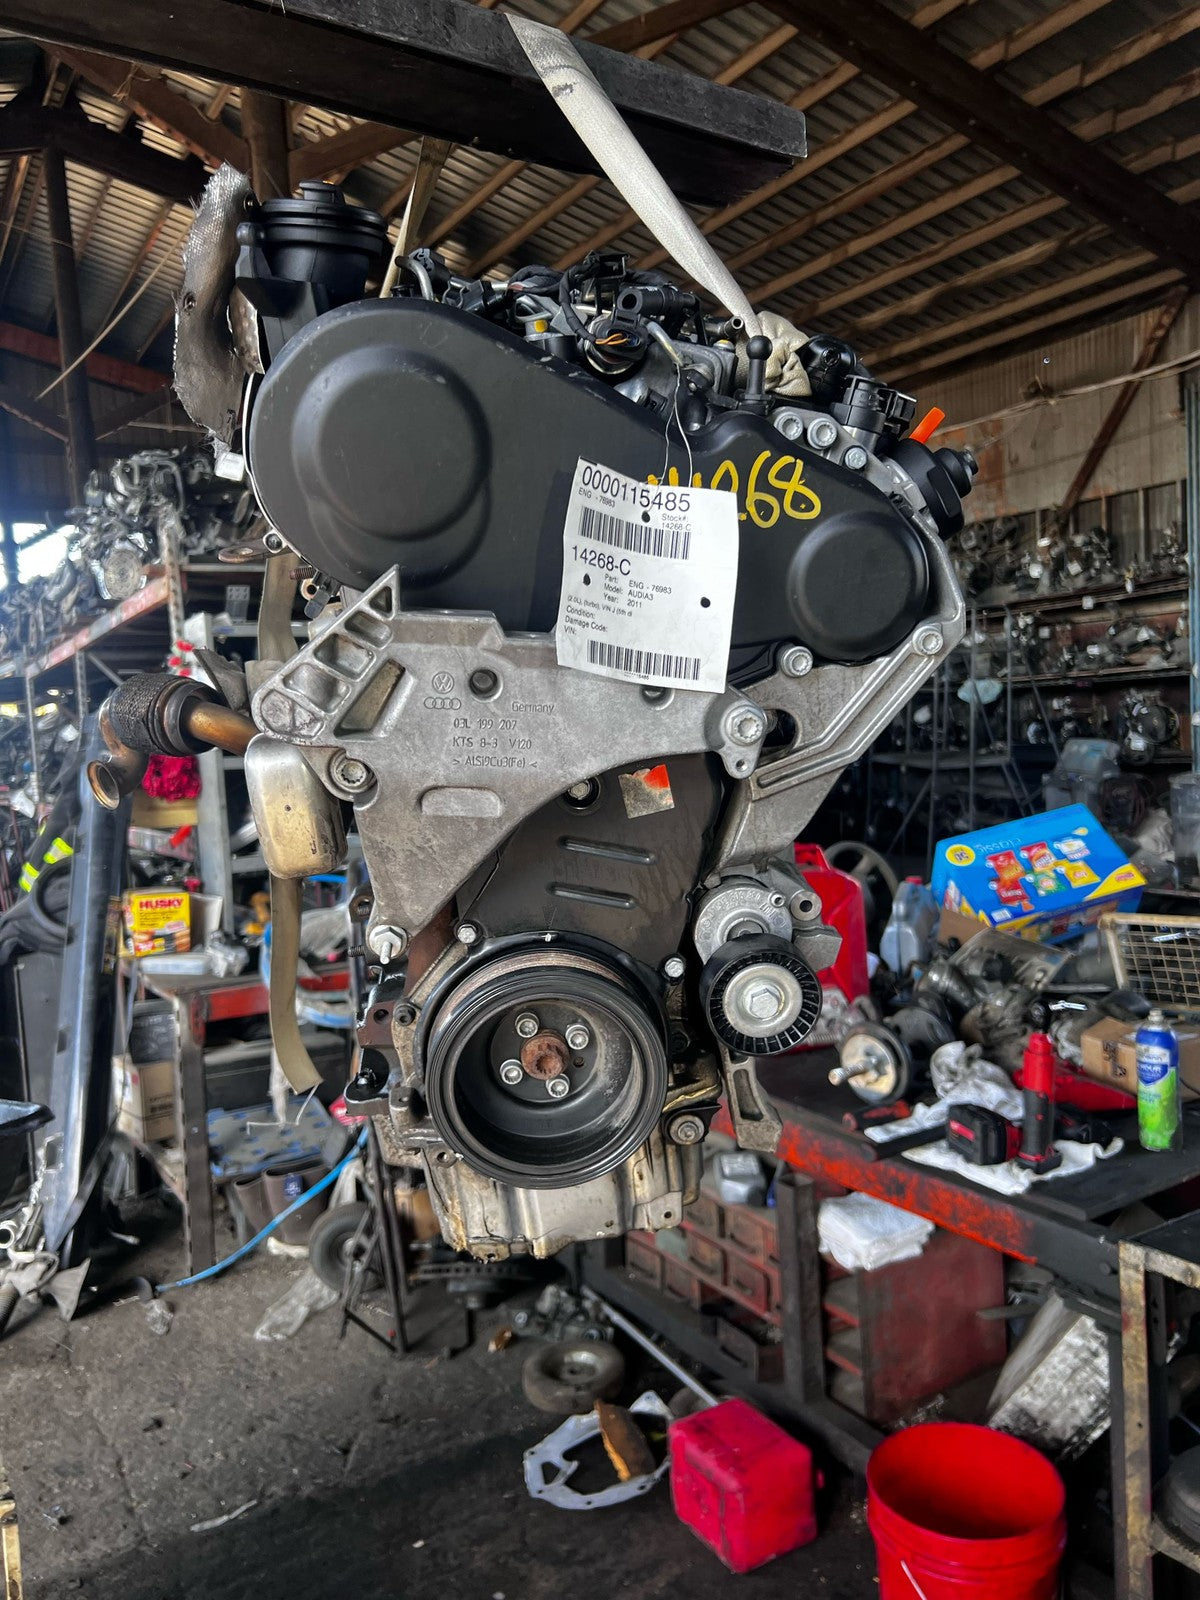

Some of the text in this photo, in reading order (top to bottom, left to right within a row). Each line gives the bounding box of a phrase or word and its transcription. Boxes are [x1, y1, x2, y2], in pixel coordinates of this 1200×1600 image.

[578, 487, 592, 499] ENG
[581, 465, 691, 512] 0000115485
[571, 545, 631, 576] 14268-C
[603, 583, 624, 594] Model:
[604, 573, 619, 583] Part:
[628, 580, 644, 590] ENG
[651, 584, 672, 595] 76983
[601, 603, 612, 612] VIN
[603, 592, 642, 608] Year: 2011
[566, 604, 596, 619] Condition:
[563, 625, 577, 635] VIN:
[564, 615, 608, 632] Damage Code:
[511, 701, 555, 716] Germany
[453, 717, 517, 731] 03L 199 207
[452, 736, 474, 748] KTS
[480, 737, 498, 748] 8-3
